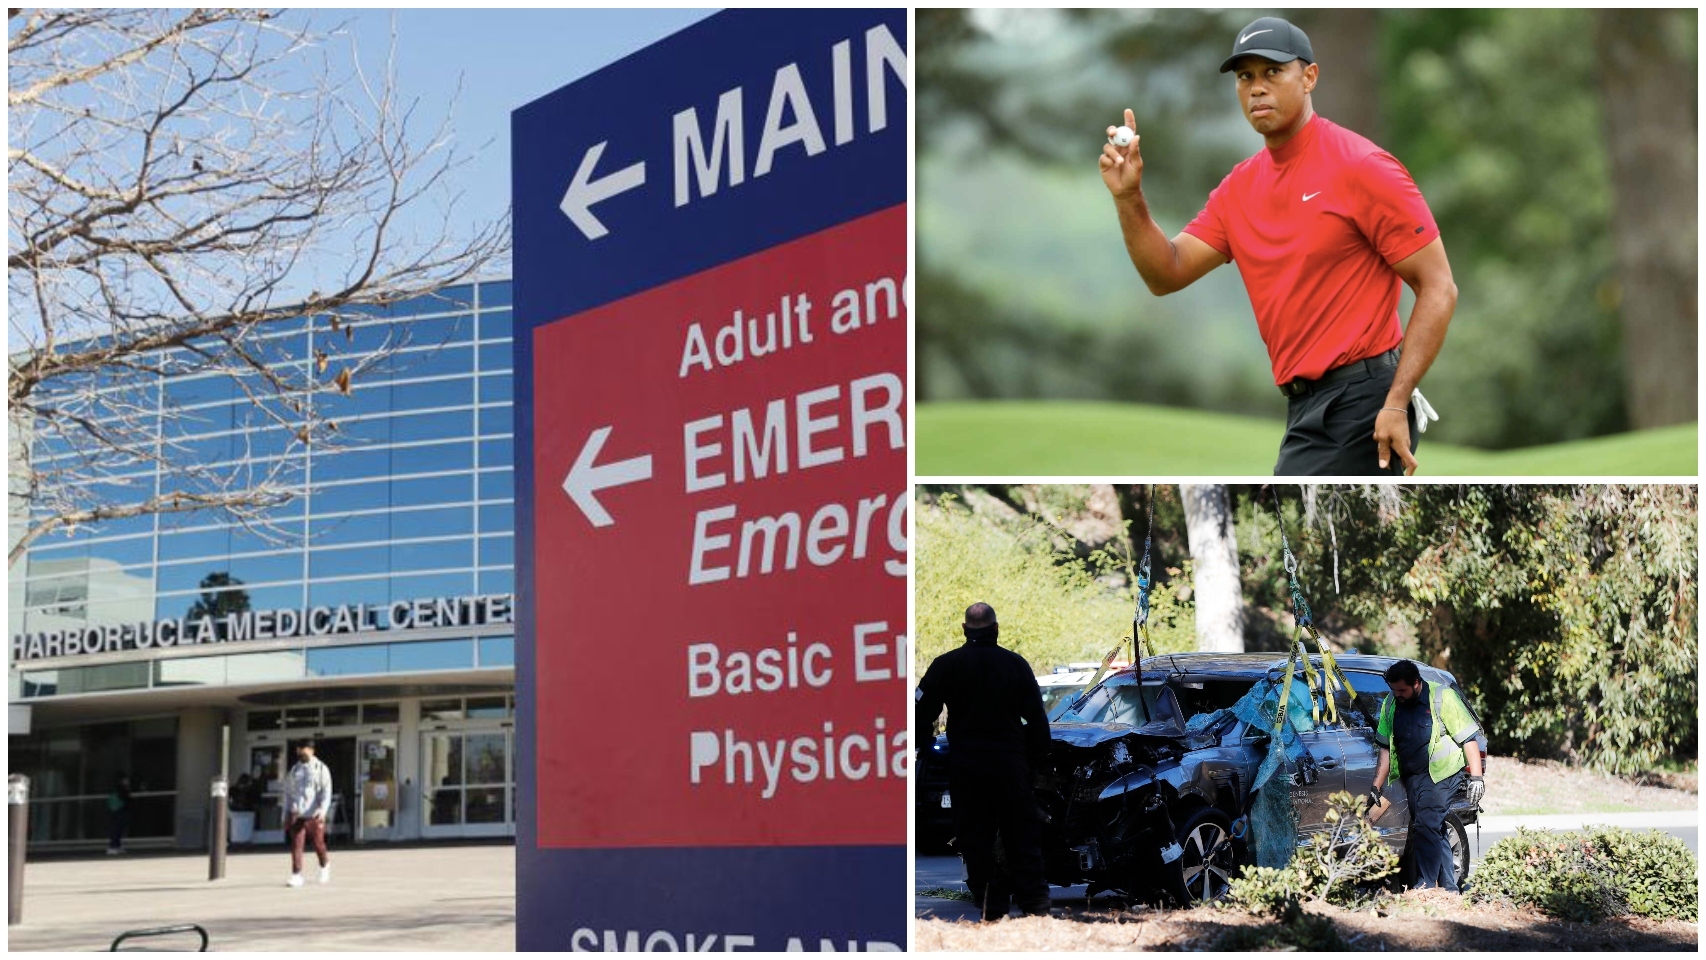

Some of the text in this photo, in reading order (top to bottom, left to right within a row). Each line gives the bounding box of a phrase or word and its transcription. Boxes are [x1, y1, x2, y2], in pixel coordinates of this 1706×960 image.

[672, 23, 907, 208] MAIN
[679, 274, 907, 378] Adult an
[684, 372, 905, 493] EMER
[12, 593, 514, 660] HARBOR-UCLA MEDICAL CENTE
[687, 621, 907, 697] Basic E
[690, 717, 907, 799] Physicia
